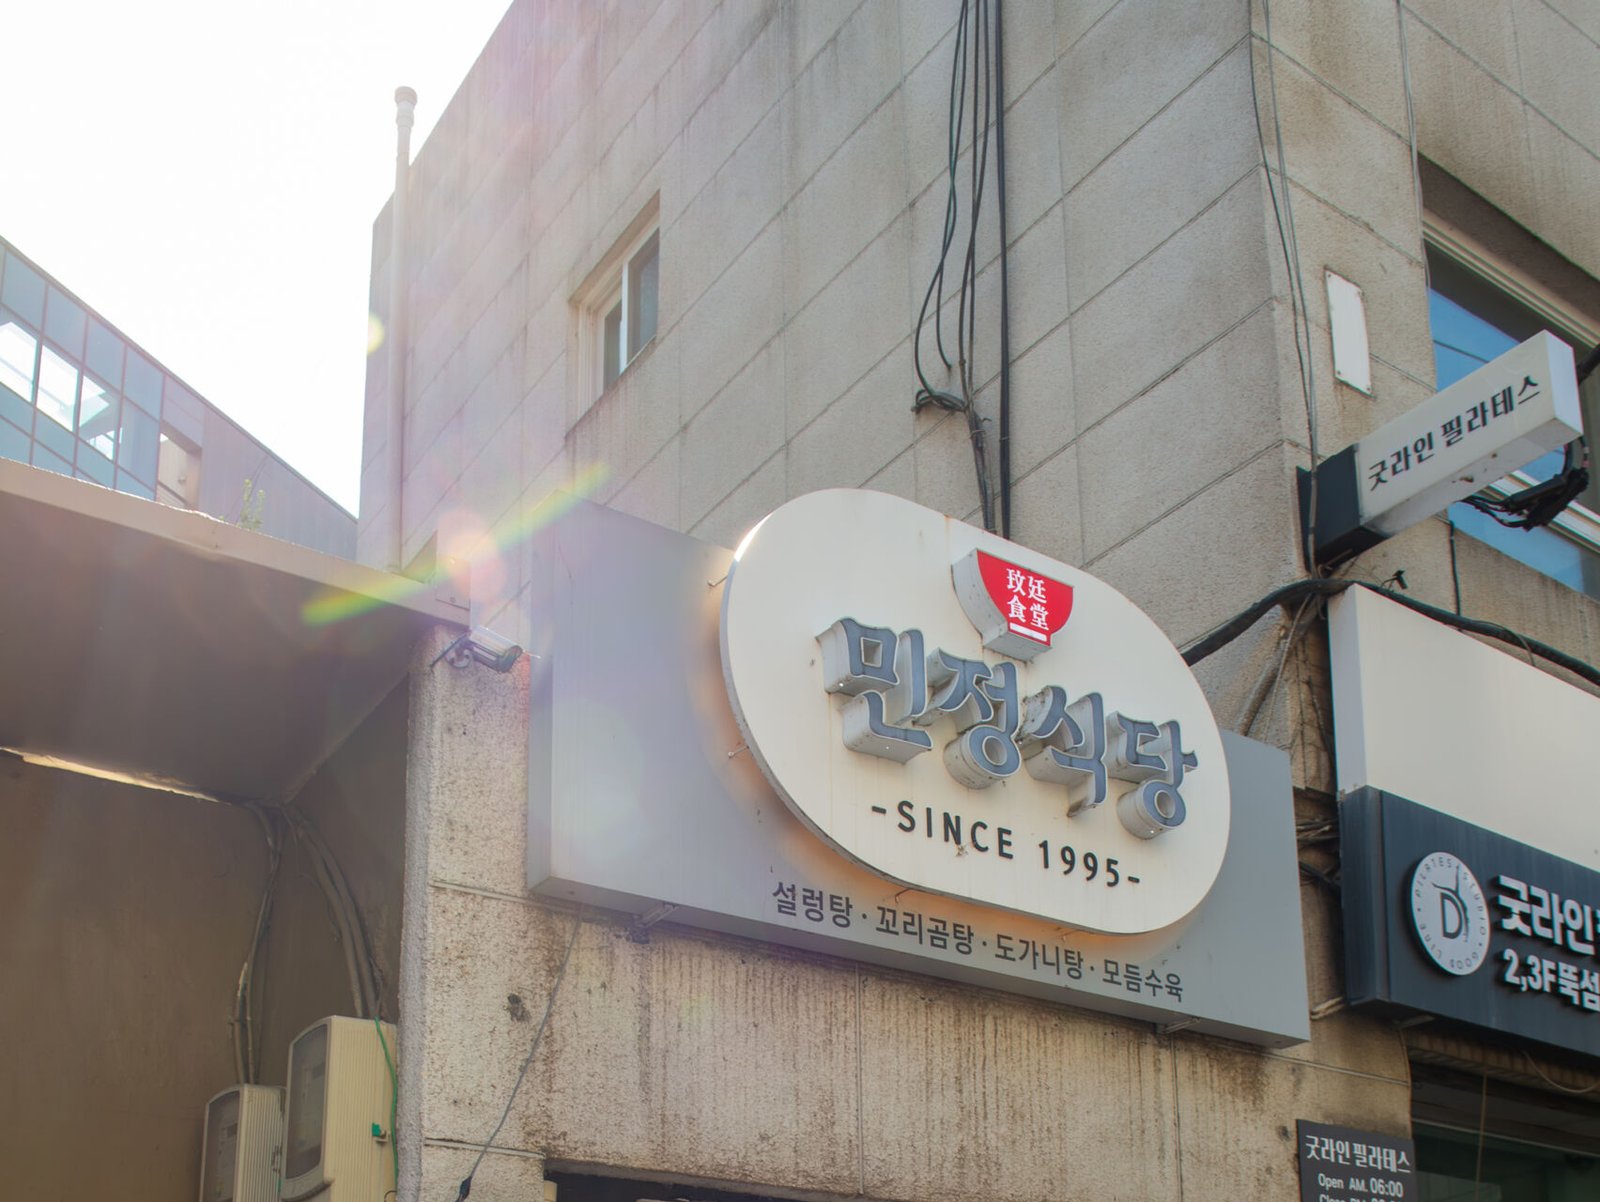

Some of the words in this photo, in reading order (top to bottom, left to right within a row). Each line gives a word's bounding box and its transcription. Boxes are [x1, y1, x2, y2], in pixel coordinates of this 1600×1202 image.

[1368, 430, 1436, 492] 굿라인
[1441, 375, 1541, 446] 필라테스
[1006, 568, 1047, 604] 玫廷
[1007, 595, 1049, 630] 食堂
[828, 617, 1198, 830] 민정식당
[771, 880, 853, 928] 설렁탕
[875, 905, 974, 956] 꼬리곰탕
[995, 938, 1084, 979] 도가니탕
[1103, 960, 1184, 1003] 모듬수육
[1305, 1135, 1351, 1166] 굿라인
[1352, 1142, 1411, 1174] 필라테스
[1317, 1173, 1344, 1190] Open
[1369, 1177, 1404, 1199] 06:00
